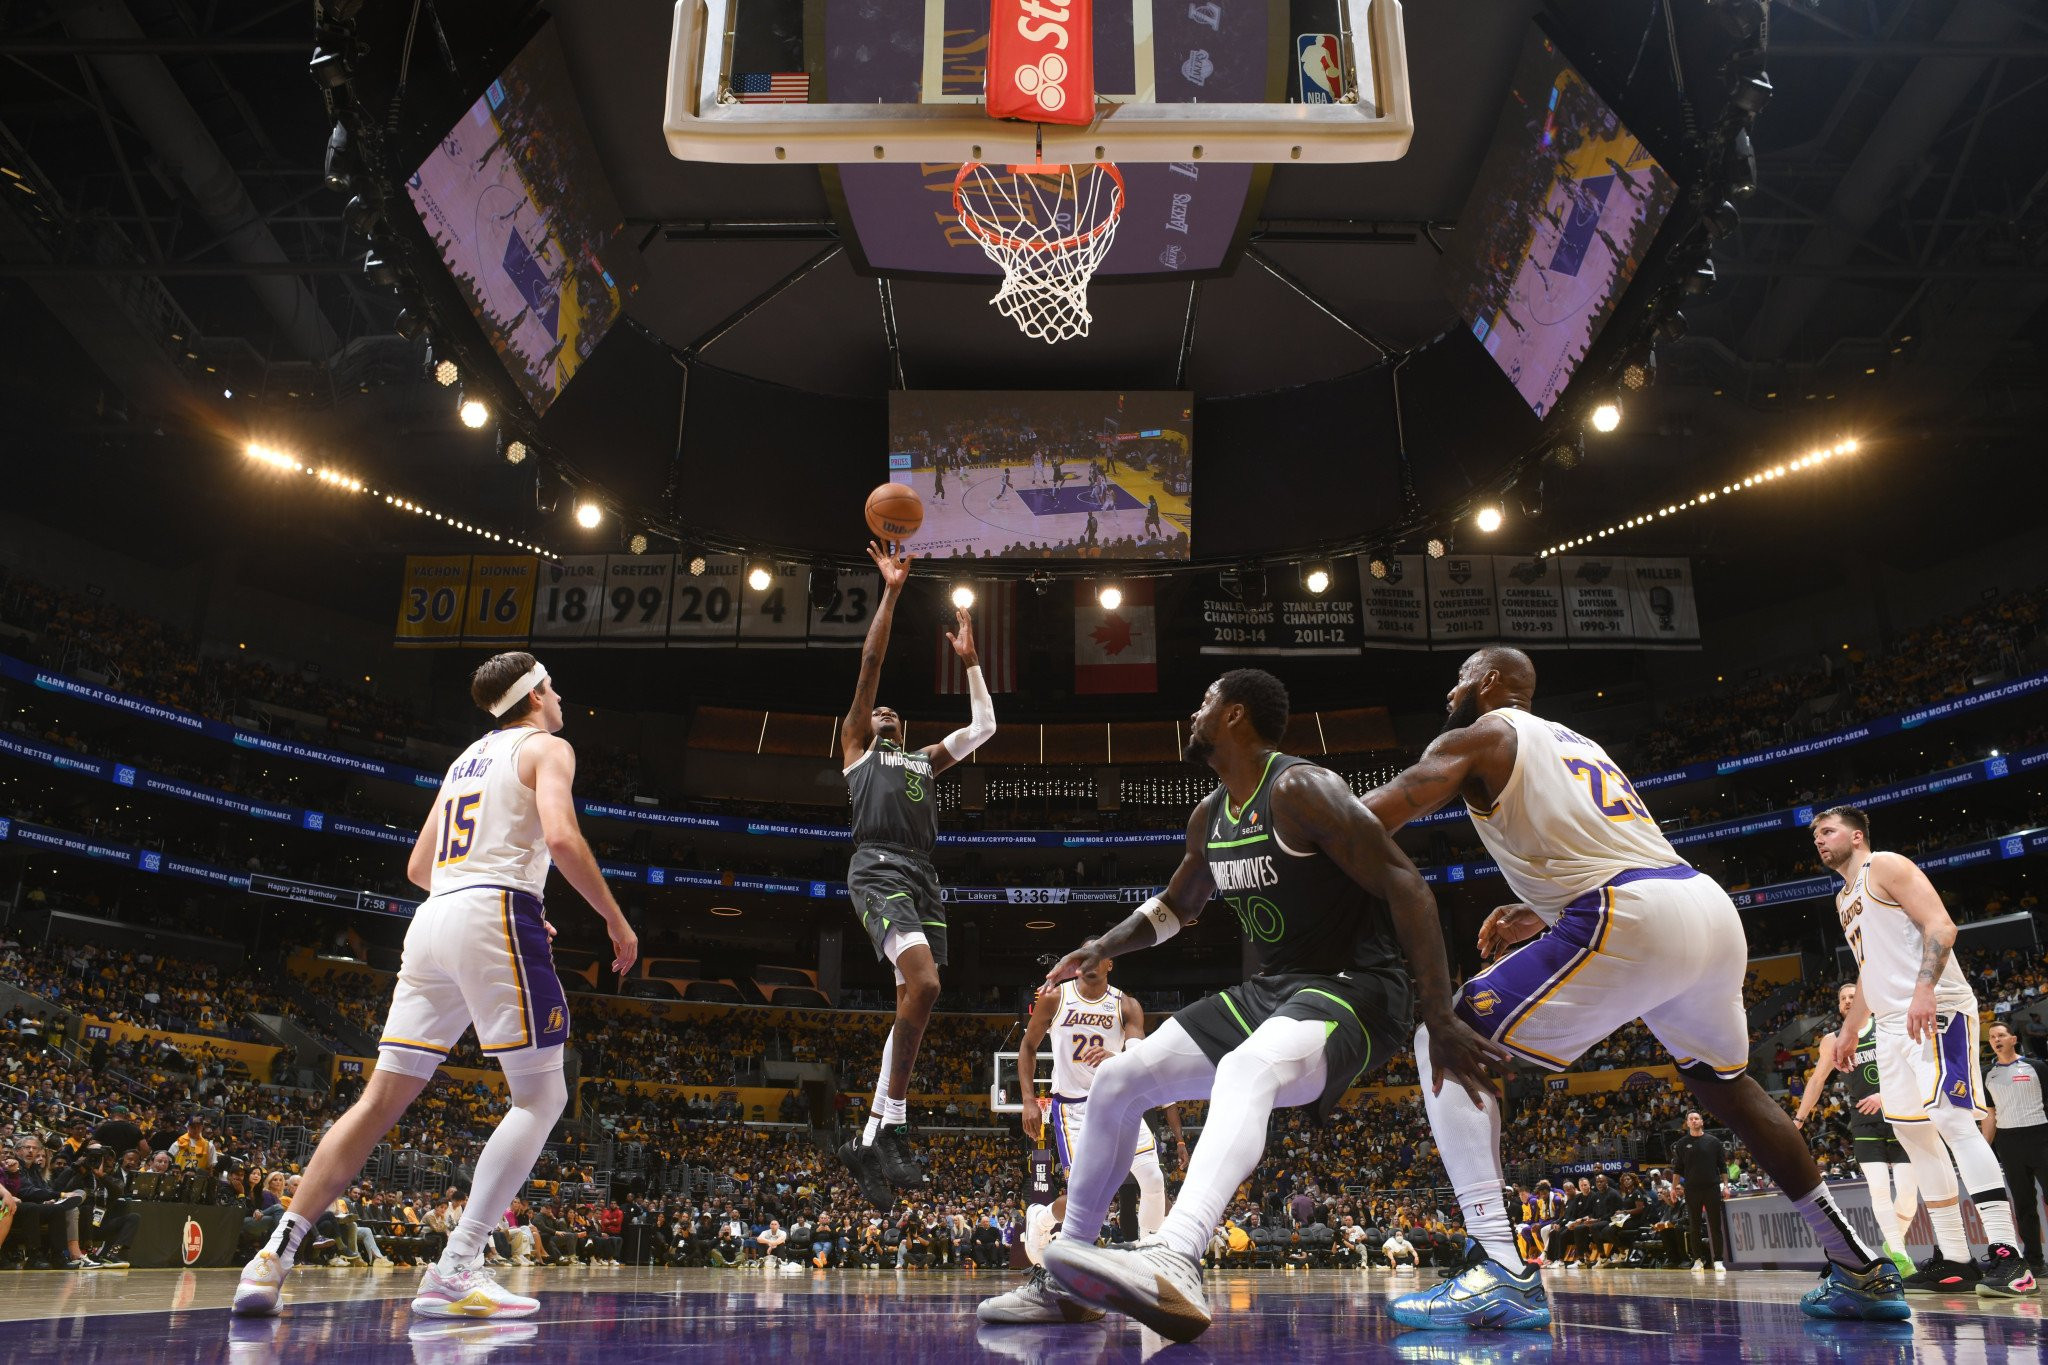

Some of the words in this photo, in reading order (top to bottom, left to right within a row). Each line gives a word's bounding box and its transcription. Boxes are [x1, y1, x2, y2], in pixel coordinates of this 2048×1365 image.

[1307, 92, 1328, 104] NBA
[1165, 193, 1192, 234] LAKERS
[480, 566, 527, 577] DIONNE
[611, 565, 665, 576] GRETZKY
[1636, 568, 1682, 580] MILLER
[1372, 588, 1414, 599] WESTERN
[1440, 588, 1484, 598] WESTERN
[1506, 588, 1552, 598] CAMPBELL
[1579, 588, 1614, 598] SMYTHE
[406, 586, 457, 624] 30
[479, 586, 518, 623] 16
[547, 587, 587, 623] 18
[610, 587, 663, 624] 99
[678, 586, 732, 623] 20
[760, 587, 785, 623] 4
[1283, 601, 1328, 612] STANLEY
[1332, 602, 1353, 612] CUP
[1366, 599, 1421, 609] CONFERENCE
[1433, 598, 1492, 609] CONFERENCE
[1502, 599, 1559, 608] CONFERENCE
[1577, 599, 1617, 608] DIVISION
[1204, 612, 1274, 624] CHAMPIONS
[1283, 612, 1354, 625] CHAMPIONS
[1370, 608, 1420, 619] CHAMPIONS
[1437, 608, 1490, 620] CHAMPIONS
[1505, 608, 1558, 618] CHAMPIONS
[1572, 608, 1625, 618] CHAMPIONS
[1377, 620, 1414, 632] 2013-14
[1446, 621, 1484, 633] 2011-12
[1511, 621, 1553, 632] 1992-93
[1580, 621, 1621, 632] 1990-91
[1214, 627, 1266, 642] 2013-14
[1294, 629, 1345, 643] 2011-12
[37, 673, 64, 688] LEARN
[67, 682, 90, 696] MORE
[92, 690, 103, 699] AT
[104, 693, 202, 729] GO.AMEX/CRYPTO-ARENA
[1901, 711, 1927, 724] LEARN
[1929, 705, 1951, 716] MORE
[1953, 700, 1963, 709] AT
[235, 732, 258, 745] LEARN
[260, 739, 281, 751] MORE
[283, 744, 292, 752] AT
[294, 748, 385, 773] GO.AMEX/CRYPTO-ARENA
[1717, 760, 1741, 771] LEARN
[1743, 755, 1764, 765] MORE
[1765, 753, 1774, 761] AT
[1776, 728, 1869, 758] GO.AMEX/CRYPTO-ARENA
[14, 743, 22, 753] IS
[23, 747, 52, 761] BETTER
[53, 755, 100, 774] #WITHAMEX
[452, 757, 493, 784] REAVES
[415, 774, 438, 785] LEARN
[905, 770, 924, 802] 3
[1560, 755, 1656, 824] 23
[1869, 793, 1891, 804] ARENA
[1892, 790, 1899, 799] IS
[1901, 784, 1927, 797] BETTER
[1928, 771, 1973, 789] #WITHAMEX
[147, 779, 191, 797] CRYPTO.COM
[192, 792, 214, 803] ARENA
[224, 800, 249, 811] BETTER
[250, 806, 291, 821] #WITHAMEX
[585, 804, 606, 813] LEARN
[608, 807, 626, 816] MORE
[638, 812, 720, 826] GO.AMEX/CRYPTO-ARENA
[334, 823, 375, 837] CRYPTO.COM
[377, 831, 398, 842] ARENA
[437, 790, 483, 868] 15
[748, 823, 769, 831] LEARN
[1242, 823, 1263, 834] sezzle
[1685, 833, 1707, 843] ARENA
[1716, 827, 1740, 837] BETTER
[1741, 818, 1782, 833] #WITHAMEX
[17, 829, 64, 846] EXPERIENCE
[65, 839, 86, 851] MORE
[87, 844, 130, 860] #WITHAMEX
[1927, 858, 1947, 868] MORE
[1948, 848, 1992, 863] #WITHAMEX
[168, 862, 208, 877] EXPERIENCE
[209, 872, 227, 882] MORE
[602, 867, 637, 878] #WITHAMEX
[675, 876, 712, 885] CRYPTO.COM
[267, 882, 289, 893] Happy
[291, 886, 306, 895] 23rd
[308, 889, 337, 901] Birthday
[765, 884, 799, 892] #WITHAMEX
[1807, 883, 1831, 895] BANK
[968, 891, 997, 900] Lakers
[1013, 889, 1049, 903] 3:36
[1059, 893, 1065, 903] 4
[1072, 892, 1117, 900] Timberwolves
[1124, 889, 1149, 902] 111
[362, 898, 385, 910] 7:58
[1152, 906, 1167, 923] 30
[1061, 1009, 1114, 1029] LAKERS
[89, 1026, 107, 1039] 114
[342, 1061, 360, 1072] 114
[1551, 1080, 1565, 1090] 117
[1036, 1163, 1047, 1173] GET
[1561, 1165, 1573, 1174] 17x
[1574, 1161, 1622, 1173] CHAIONS
[1759, 1211, 1812, 1249] PLAYOFFS
